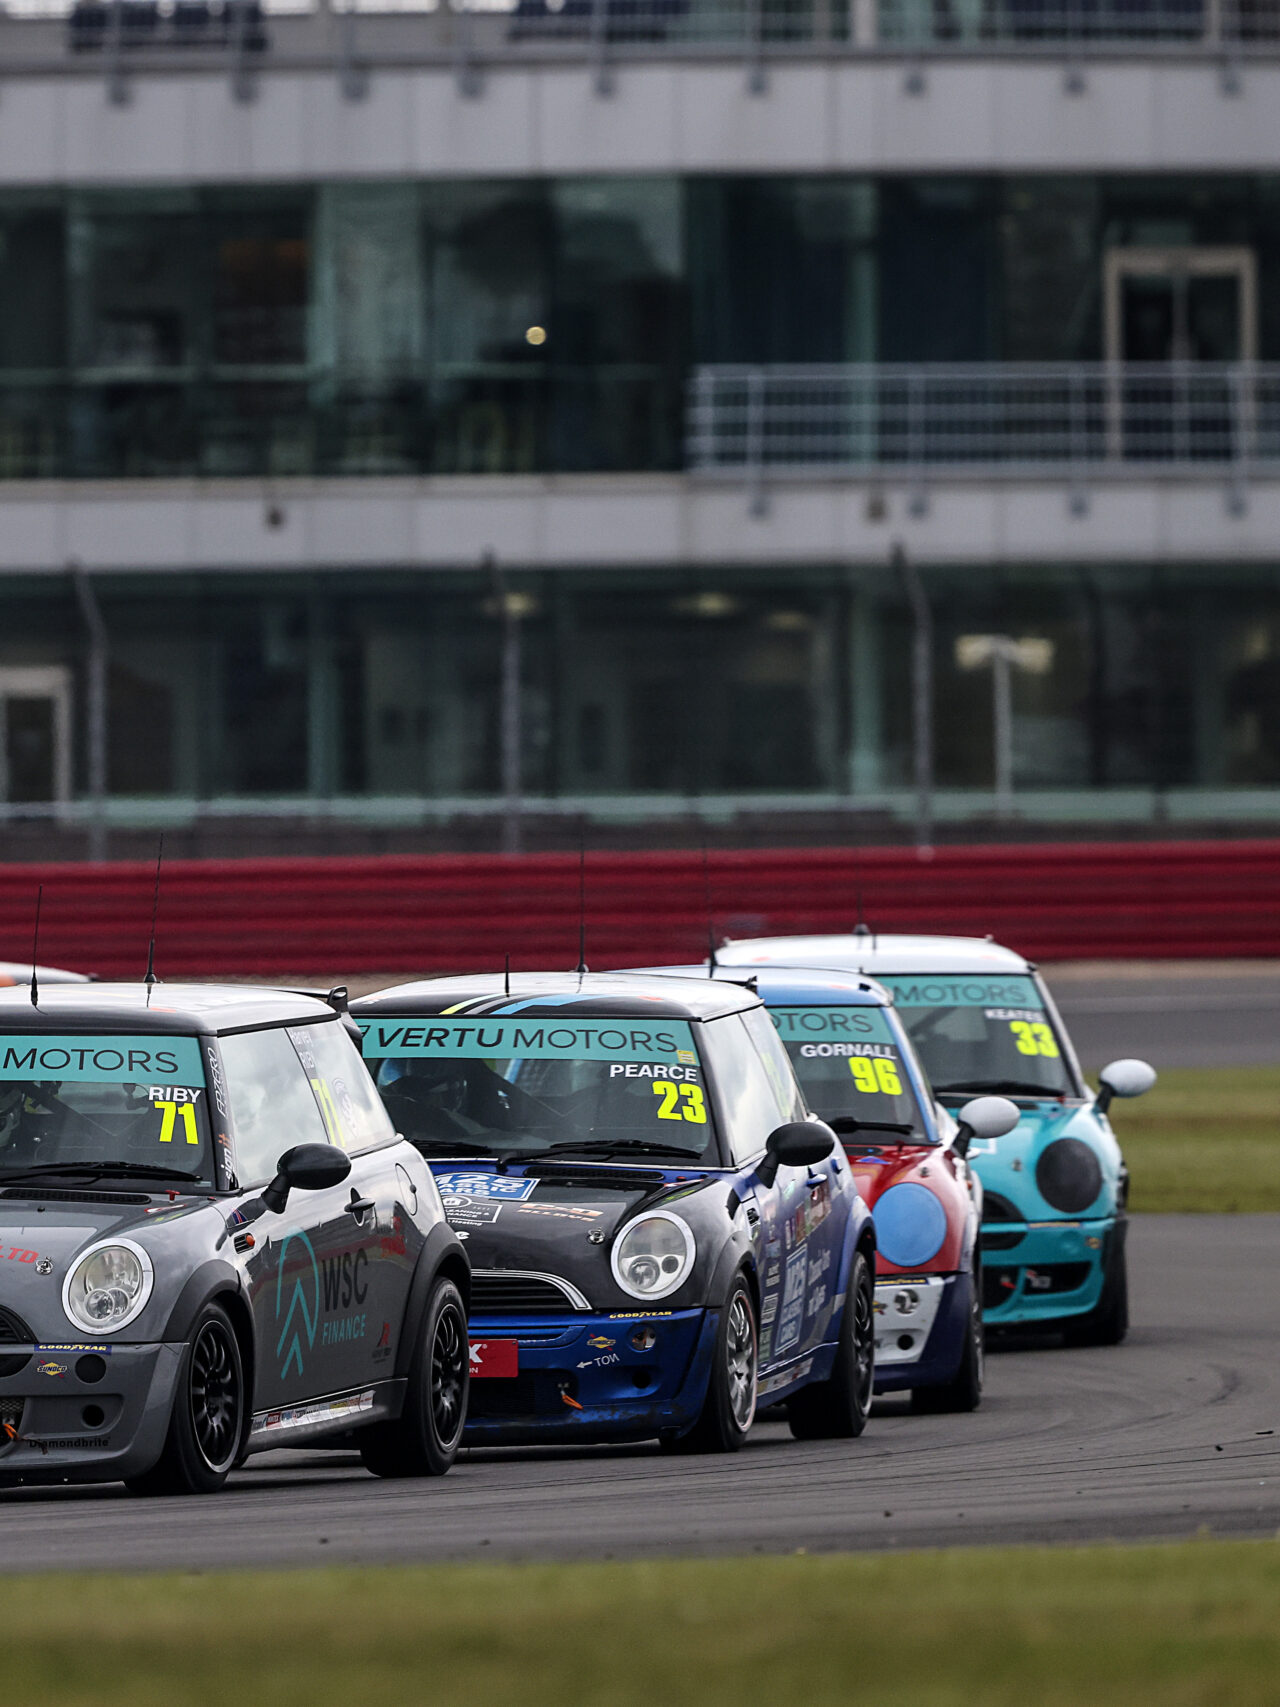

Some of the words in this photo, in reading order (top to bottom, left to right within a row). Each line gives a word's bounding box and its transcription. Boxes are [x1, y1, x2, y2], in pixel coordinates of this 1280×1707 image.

[893, 983, 1027, 1003] MOTORS
[769, 1012, 874, 1033] TORS
[984, 1009, 1045, 1023] KEATES
[377, 1027, 504, 1048] VERTU
[512, 1028, 678, 1053] MOTORS
[1009, 1020, 1060, 1058] 33
[2, 1048, 179, 1074] MOTORS
[800, 1043, 897, 1060] GORNALL
[609, 1063, 698, 1082] PEARCE
[848, 1056, 903, 1096] 96
[148, 1086, 202, 1104] RIBY
[652, 1081, 708, 1124] 23
[153, 1100, 199, 1145] 71
[439, 1187, 491, 1196] ARS
[321, 1247, 369, 1313] WSC
[609, 1310, 673, 1319] GOODYEAR
[321, 1314, 367, 1345] FINANCE
[38, 1344, 108, 1352] GOODYEAR
[36, 1365, 68, 1373] SUNOCO
